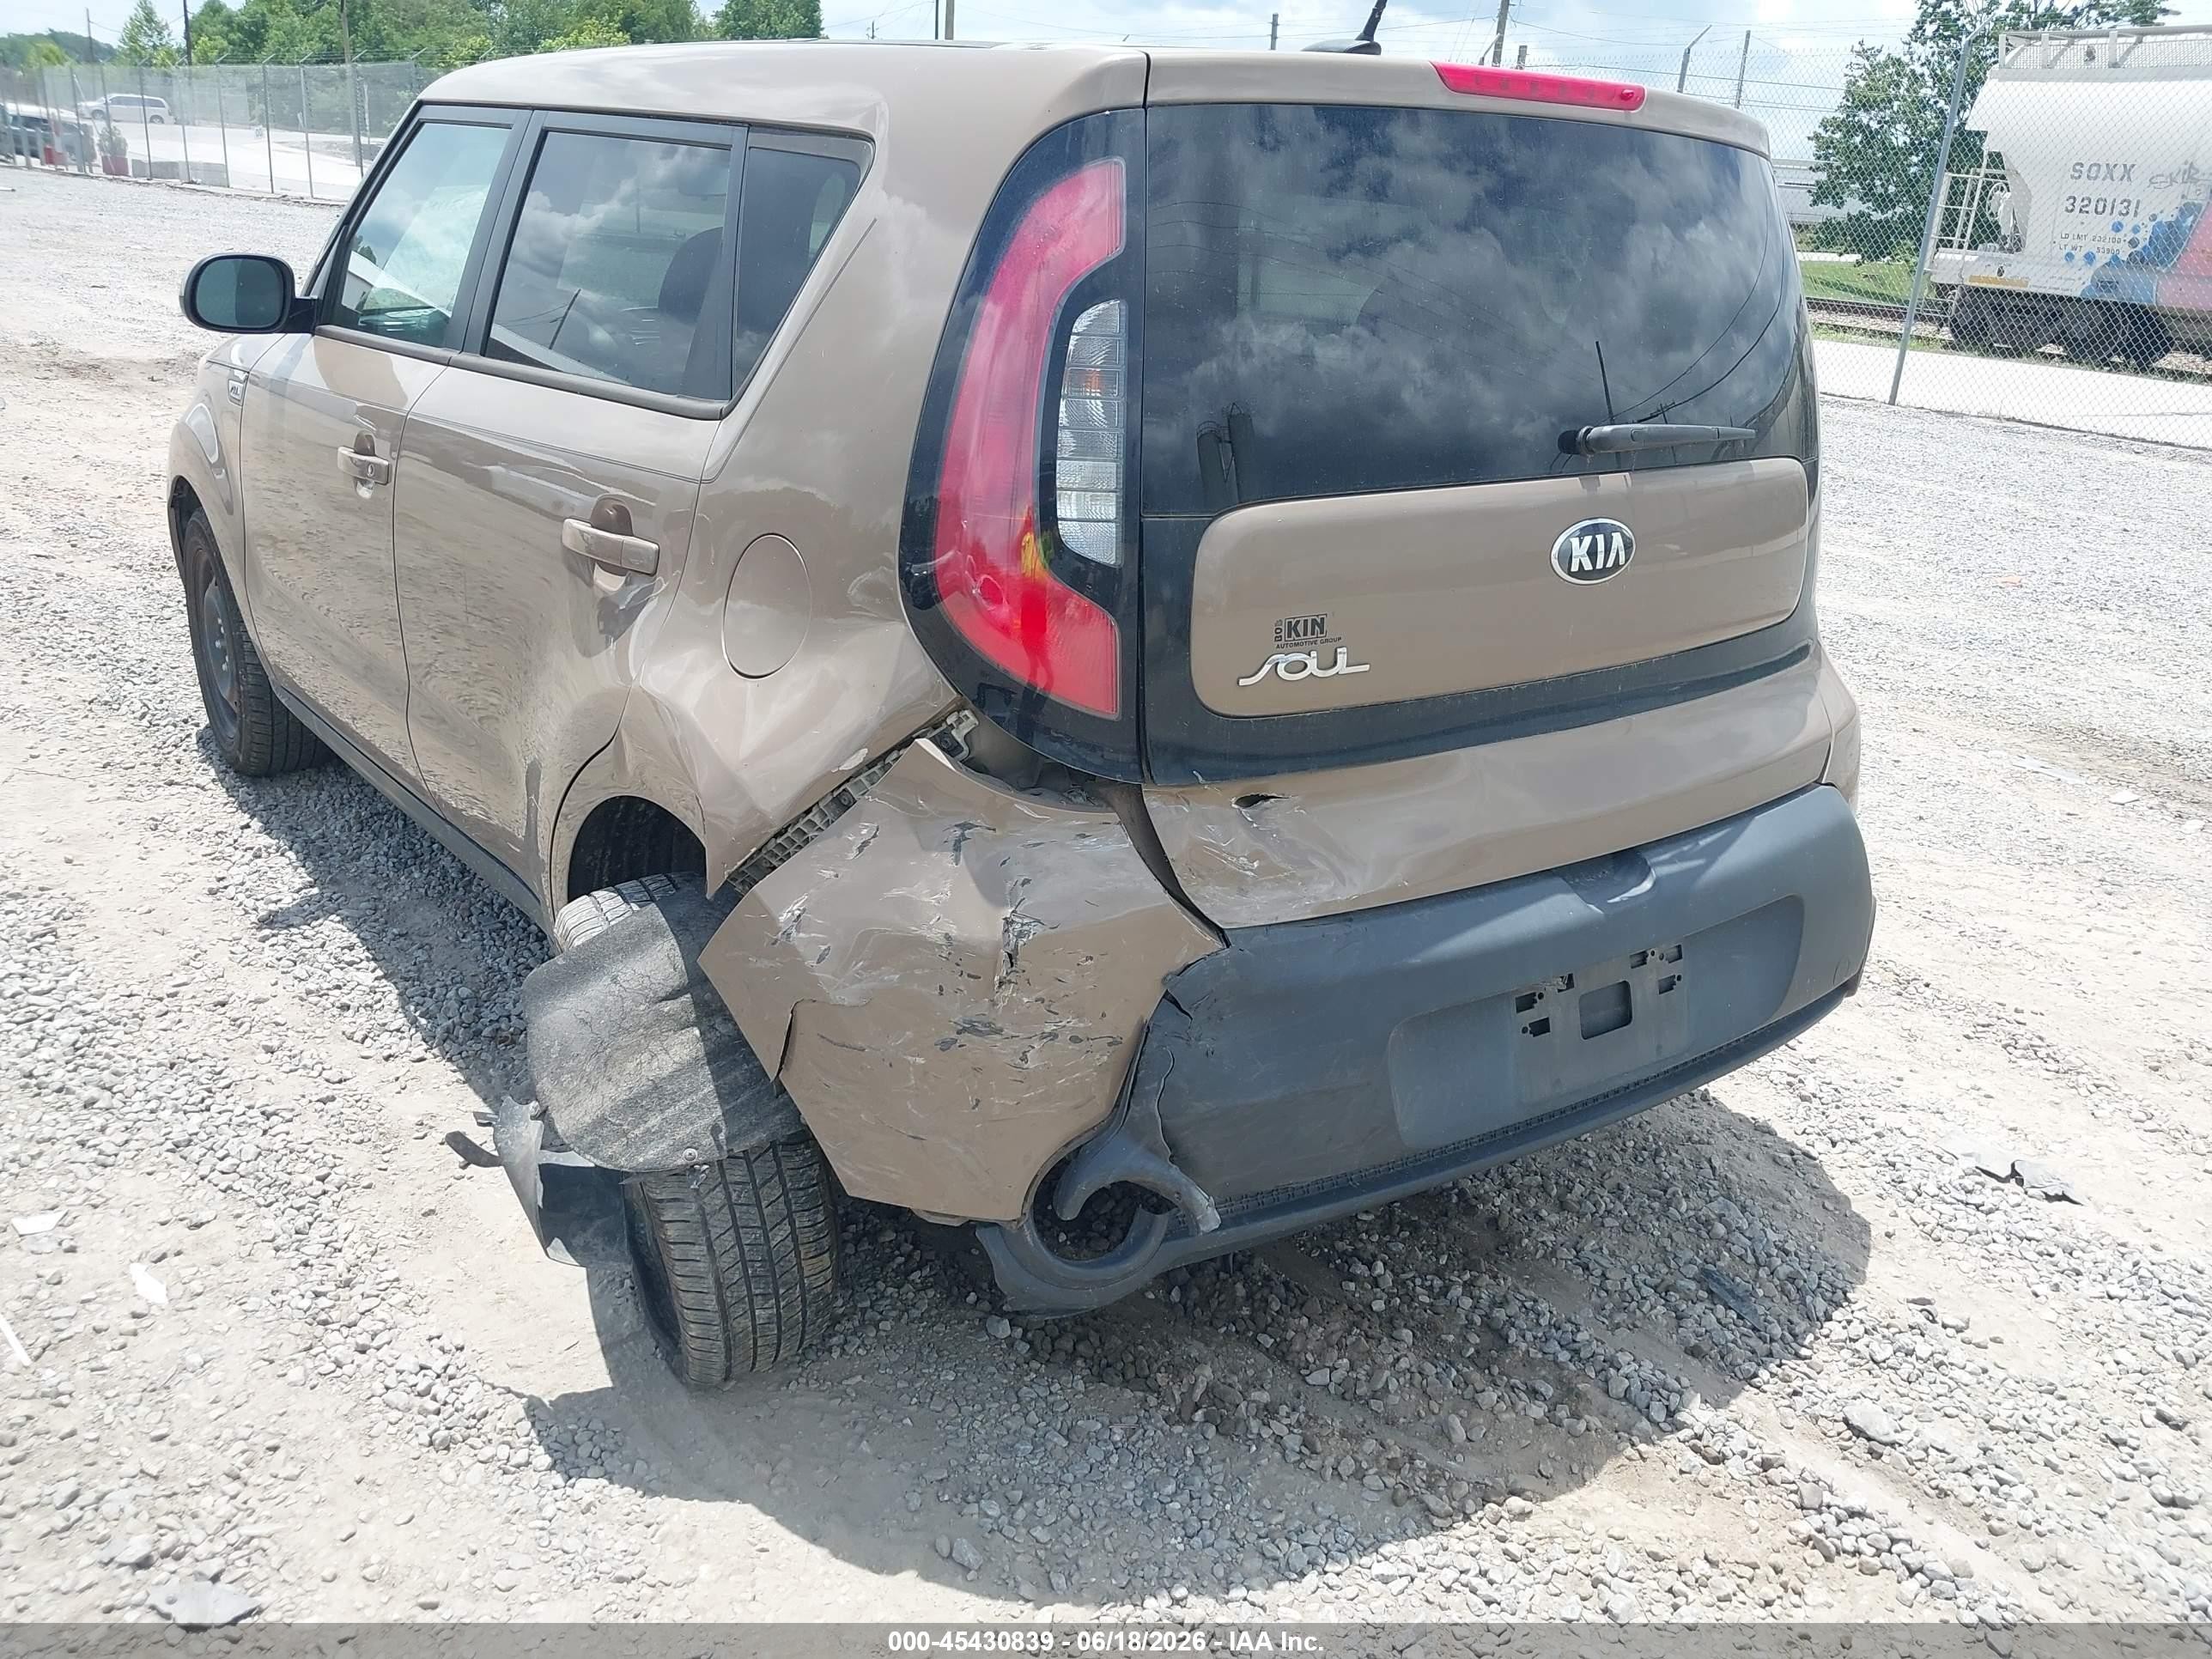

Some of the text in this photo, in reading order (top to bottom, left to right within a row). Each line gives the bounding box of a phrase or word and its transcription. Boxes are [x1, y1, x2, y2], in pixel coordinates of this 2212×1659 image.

[2070, 161, 2136, 182] SOXX
[2064, 195, 2141, 217] 320131
[1568, 532, 1626, 572] KIA
[1276, 636, 1342, 649] AUTOMOTIVE GROUP
